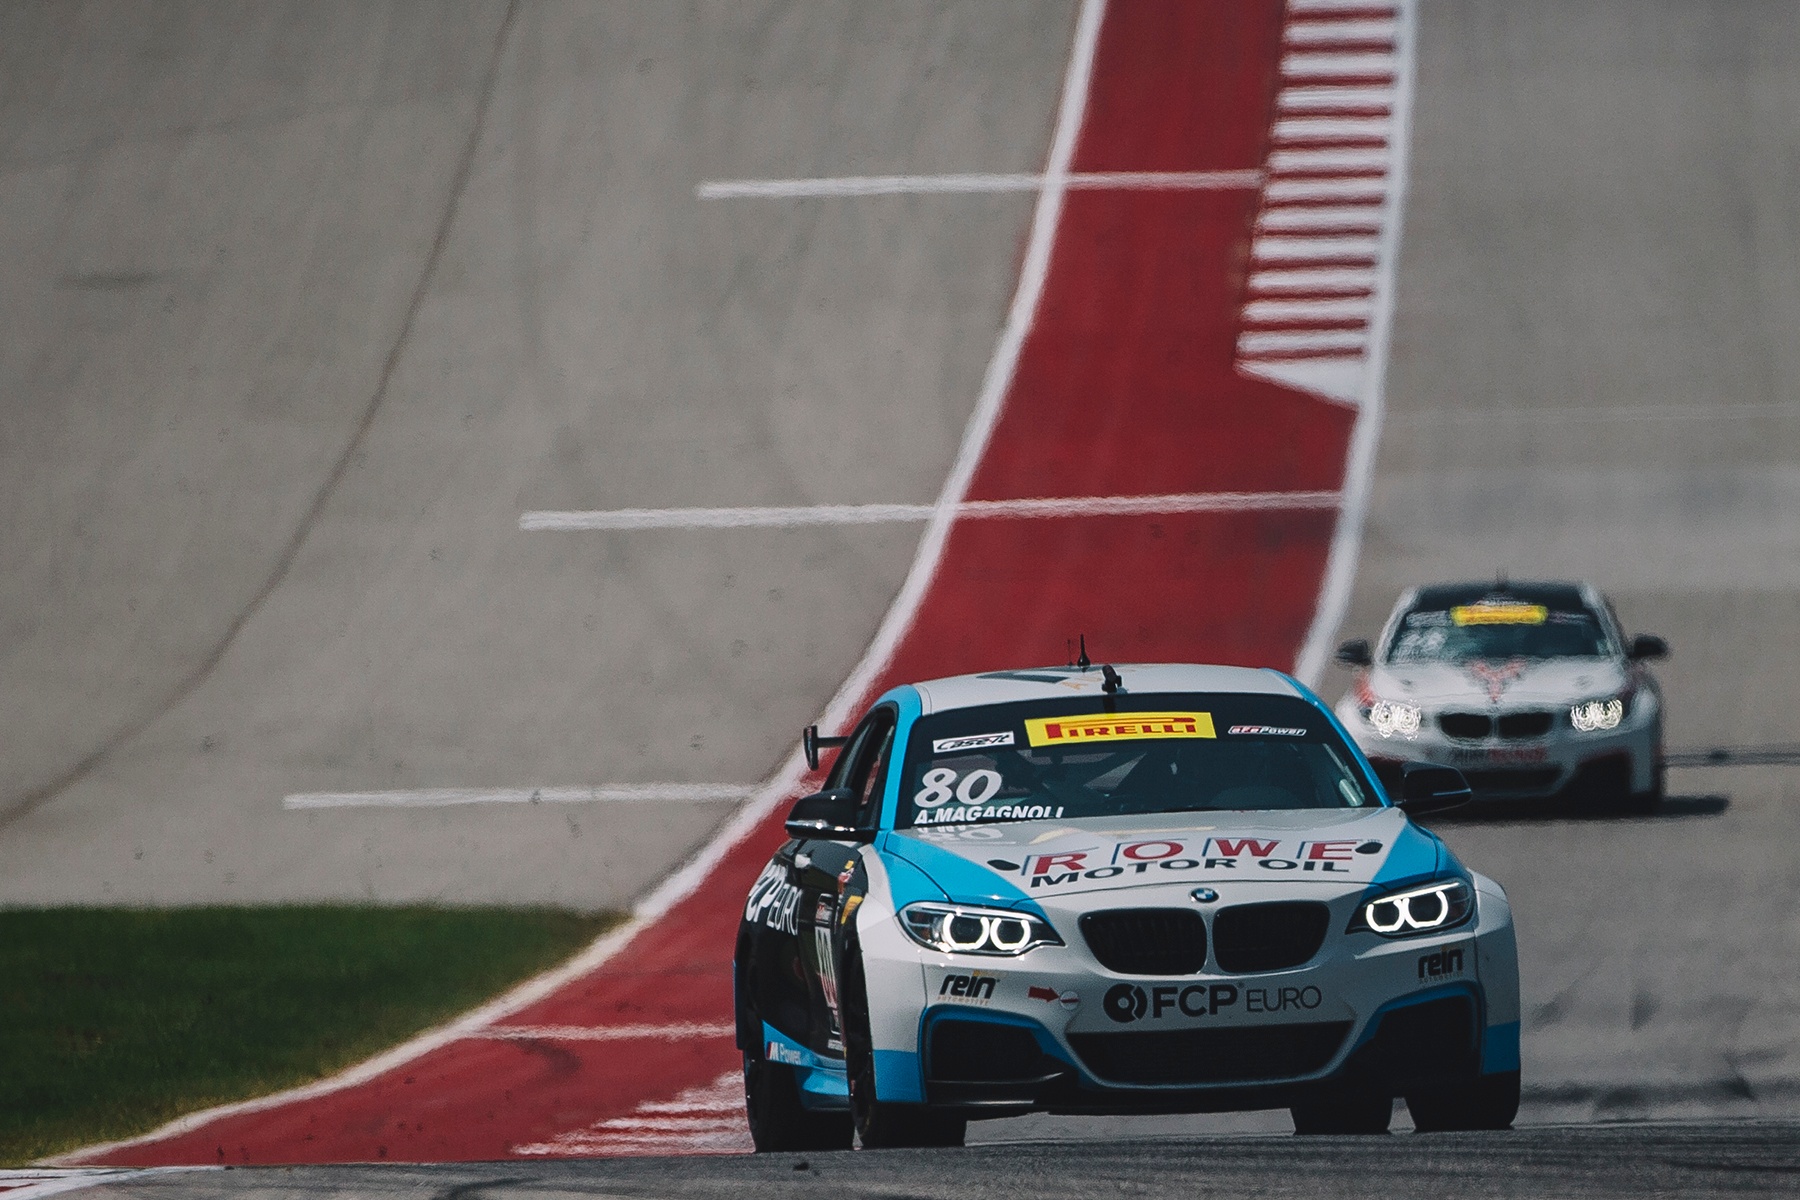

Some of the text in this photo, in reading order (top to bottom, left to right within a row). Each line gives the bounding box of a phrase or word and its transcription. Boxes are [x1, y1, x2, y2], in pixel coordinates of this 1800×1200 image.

[1045, 717, 1197, 739] PIRELLI
[914, 768, 1002, 808] 80
[914, 806, 1064, 825] A.MAGAGNOLI
[1022, 837, 1357, 876] ROWE
[1031, 858, 1349, 888] MOTOR OIL
[1418, 946, 1463, 978] rein
[939, 970, 996, 999] rein
[1152, 984, 1323, 1018] FCP EURO
